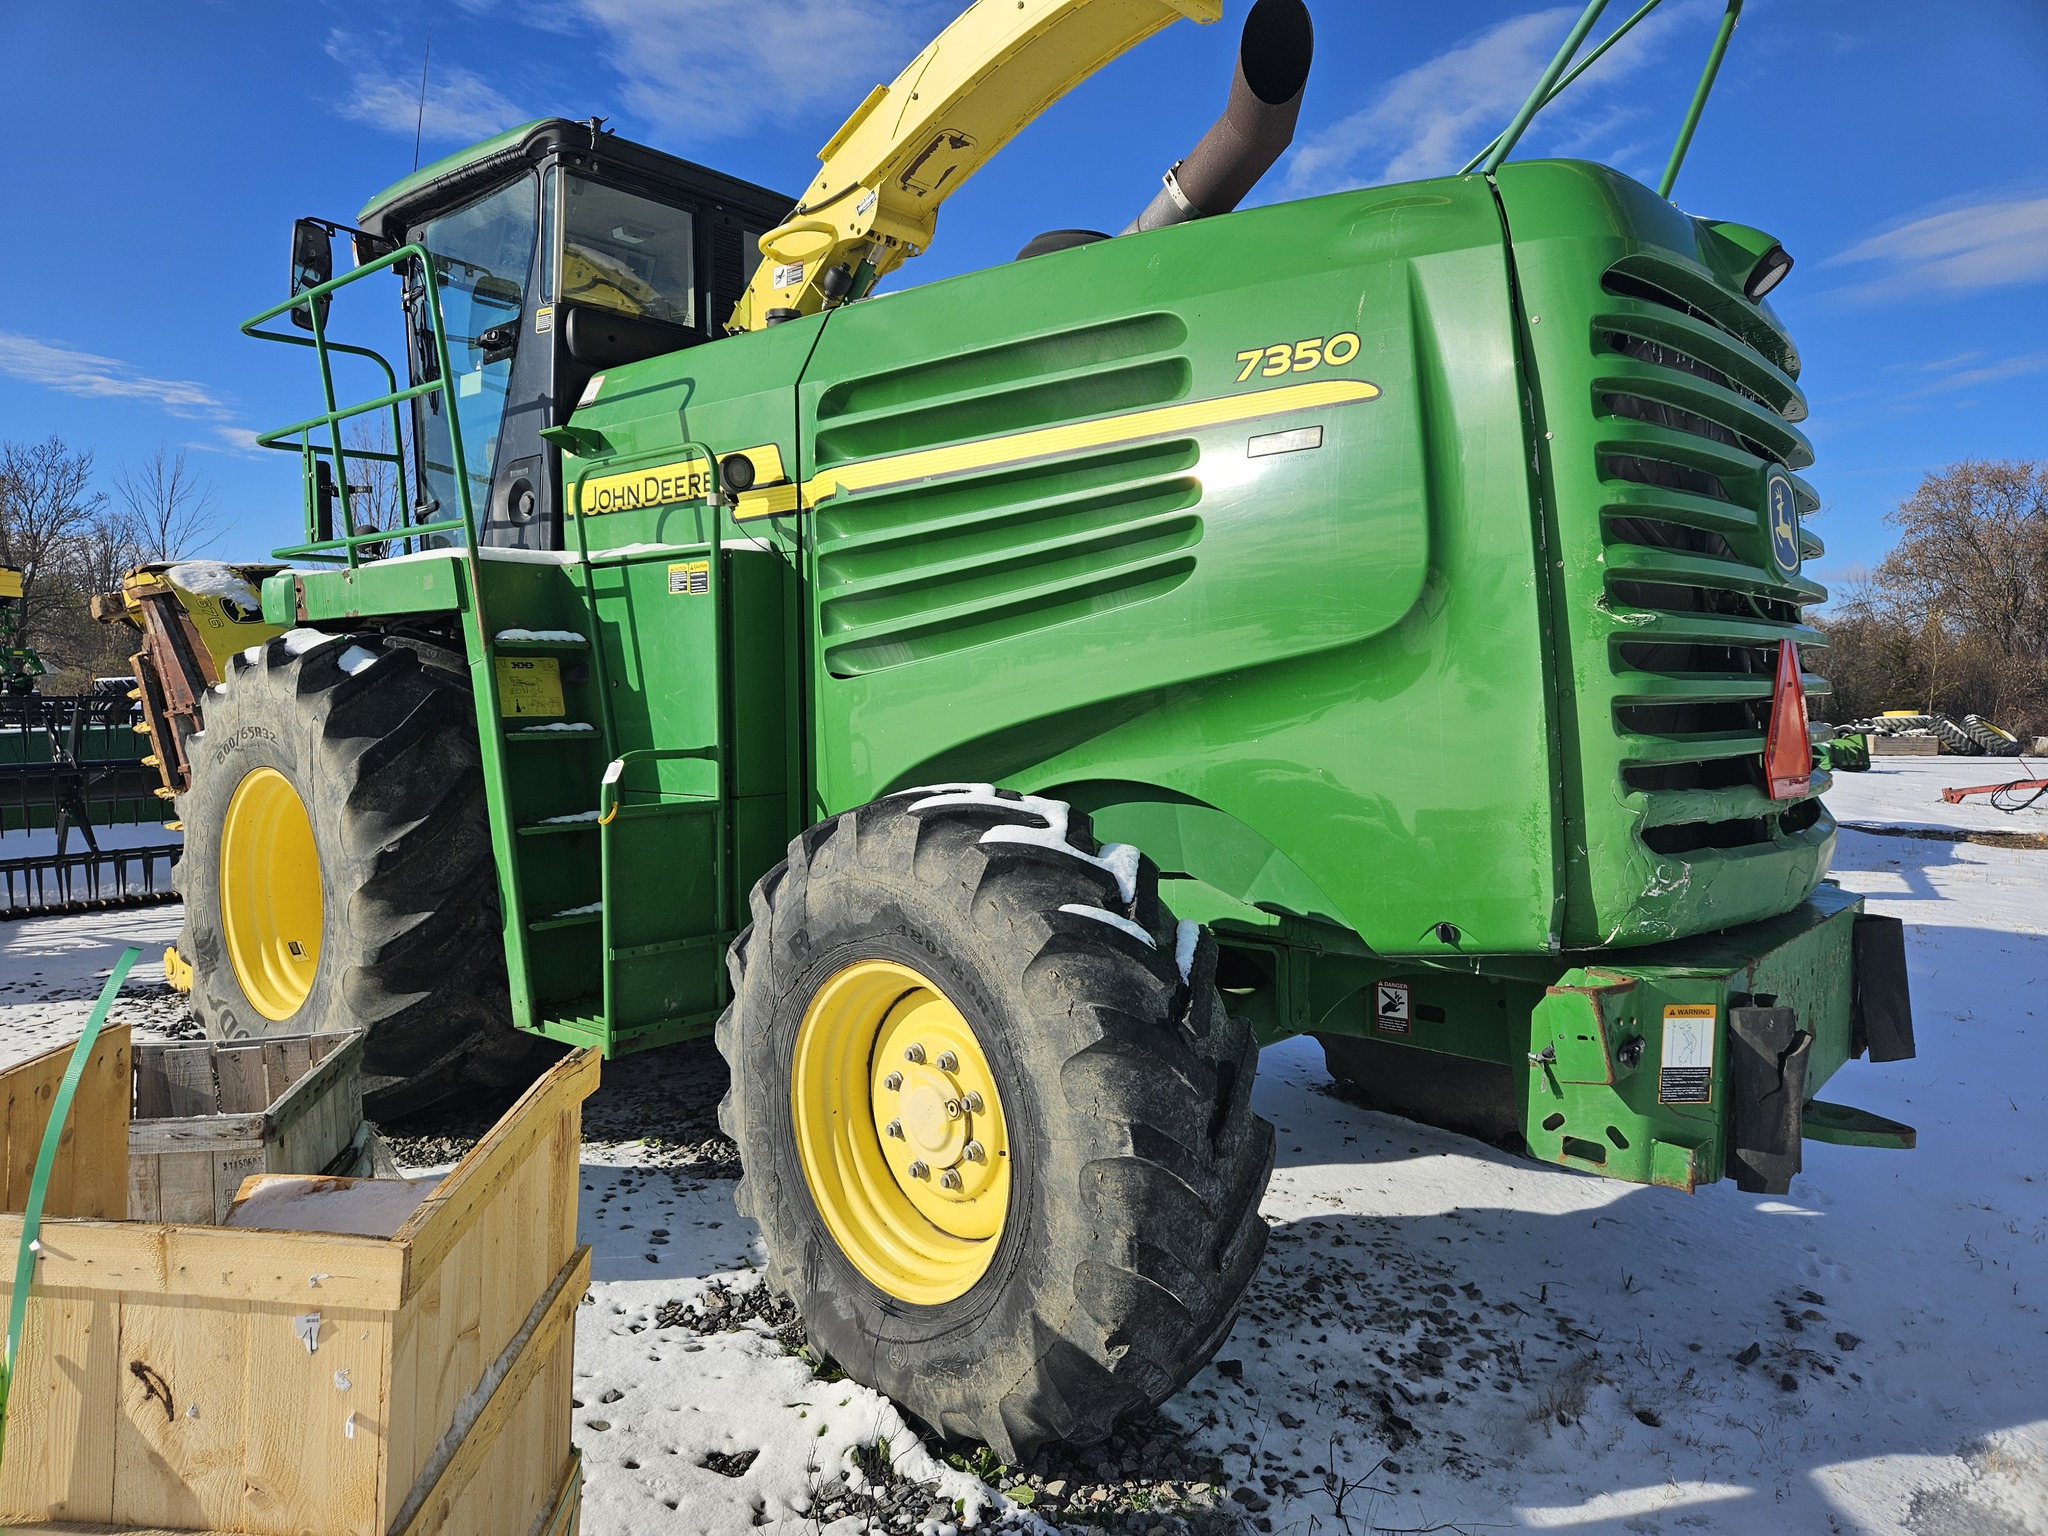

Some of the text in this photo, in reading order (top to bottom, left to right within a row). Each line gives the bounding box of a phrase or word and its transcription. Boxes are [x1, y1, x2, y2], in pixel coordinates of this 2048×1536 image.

[1233, 331, 1361, 384] 7350
[587, 471, 711, 513] JOHN DEERE
[216, 726, 280, 766] 800/65R32
[1384, 981, 1408, 990] DANGER
[1677, 1008, 1711, 1016] WARNING
